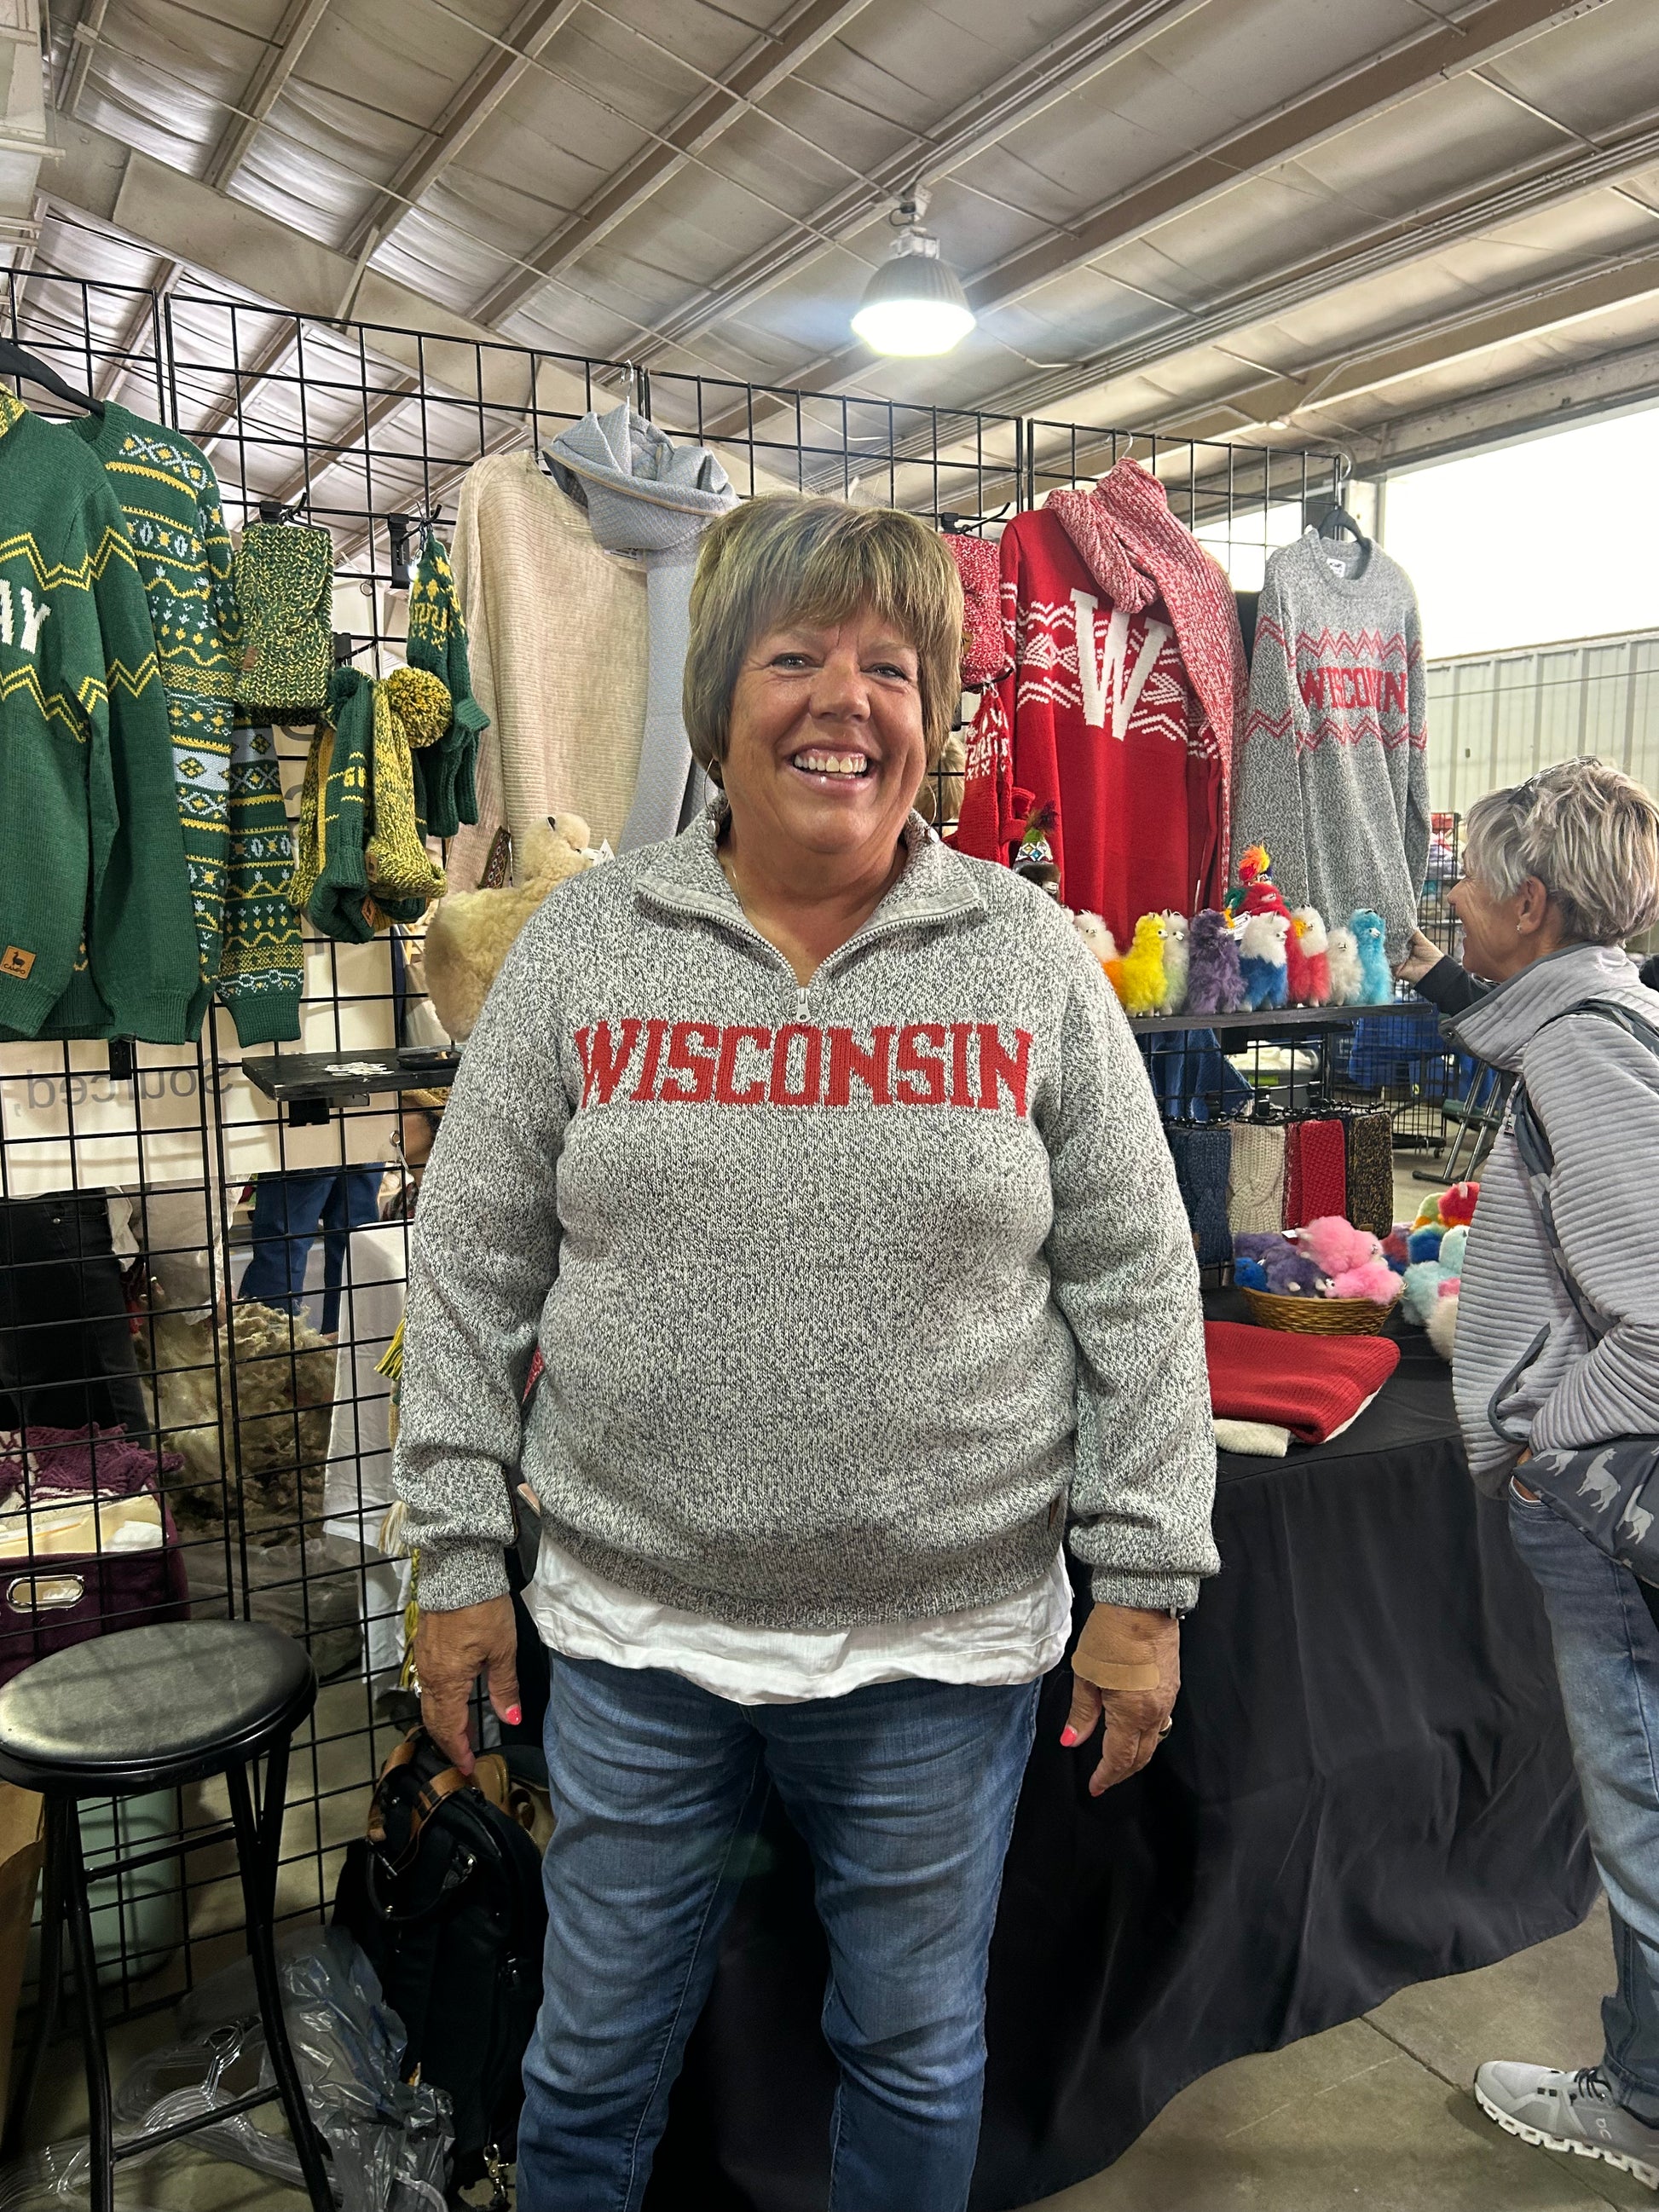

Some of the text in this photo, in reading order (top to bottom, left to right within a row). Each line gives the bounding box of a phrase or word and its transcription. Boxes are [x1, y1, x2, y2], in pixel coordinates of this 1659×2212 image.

[1070, 588, 1174, 742] W
[1297, 666, 1407, 714] WISCOIN
[574, 1018, 1032, 1118] WISCONSIN
